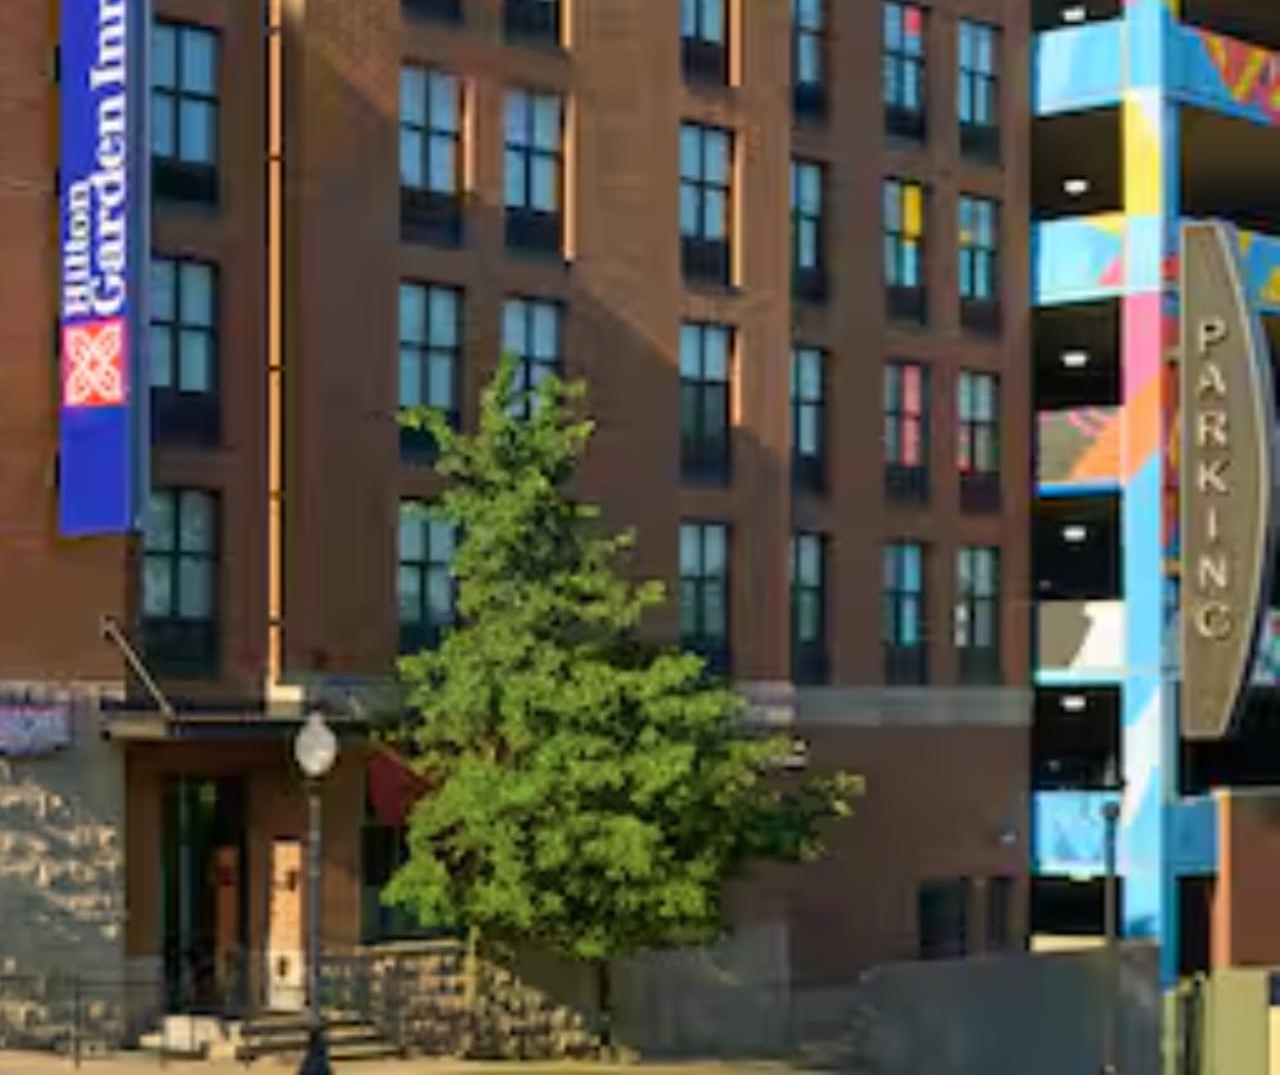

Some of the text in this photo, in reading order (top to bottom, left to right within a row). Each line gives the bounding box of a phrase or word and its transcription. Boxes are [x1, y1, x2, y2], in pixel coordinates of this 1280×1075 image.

[65, 180, 91, 316] Hilton
[90, 97, 127, 315] Garden
[1196, 319, 1231, 639] PARKING
